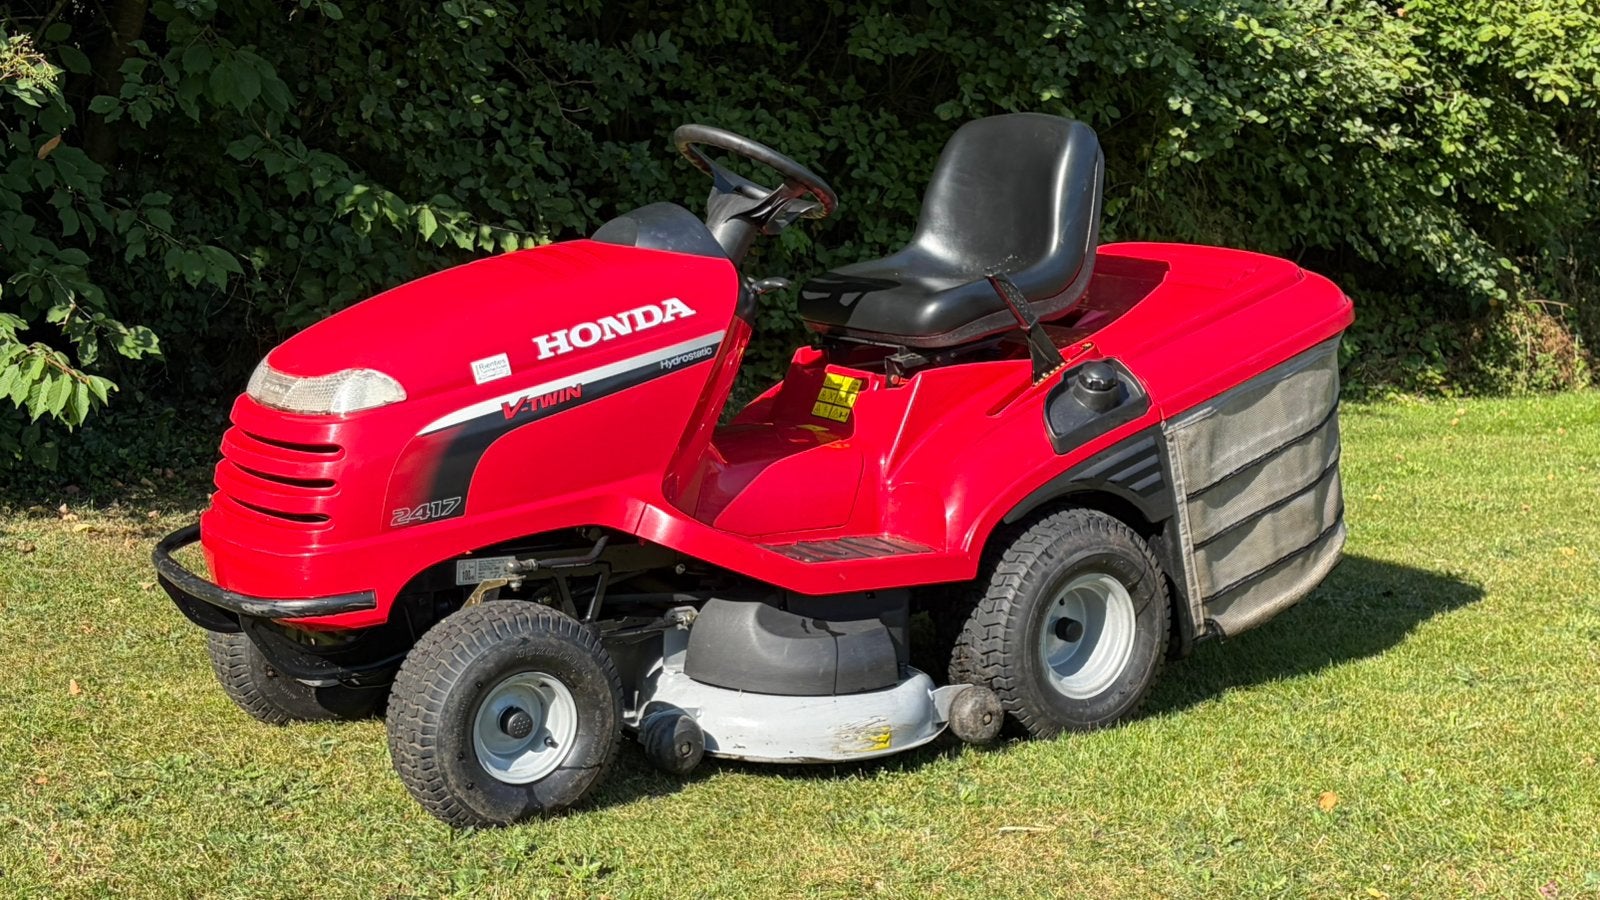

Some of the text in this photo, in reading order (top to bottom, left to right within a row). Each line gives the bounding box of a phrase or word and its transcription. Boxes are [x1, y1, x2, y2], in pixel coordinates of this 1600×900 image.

[533, 297, 696, 360] HONDA
[660, 346, 714, 370] Hydrostatic
[501, 383, 582, 420] V-TWIN
[390, 496, 463, 523] 2417
